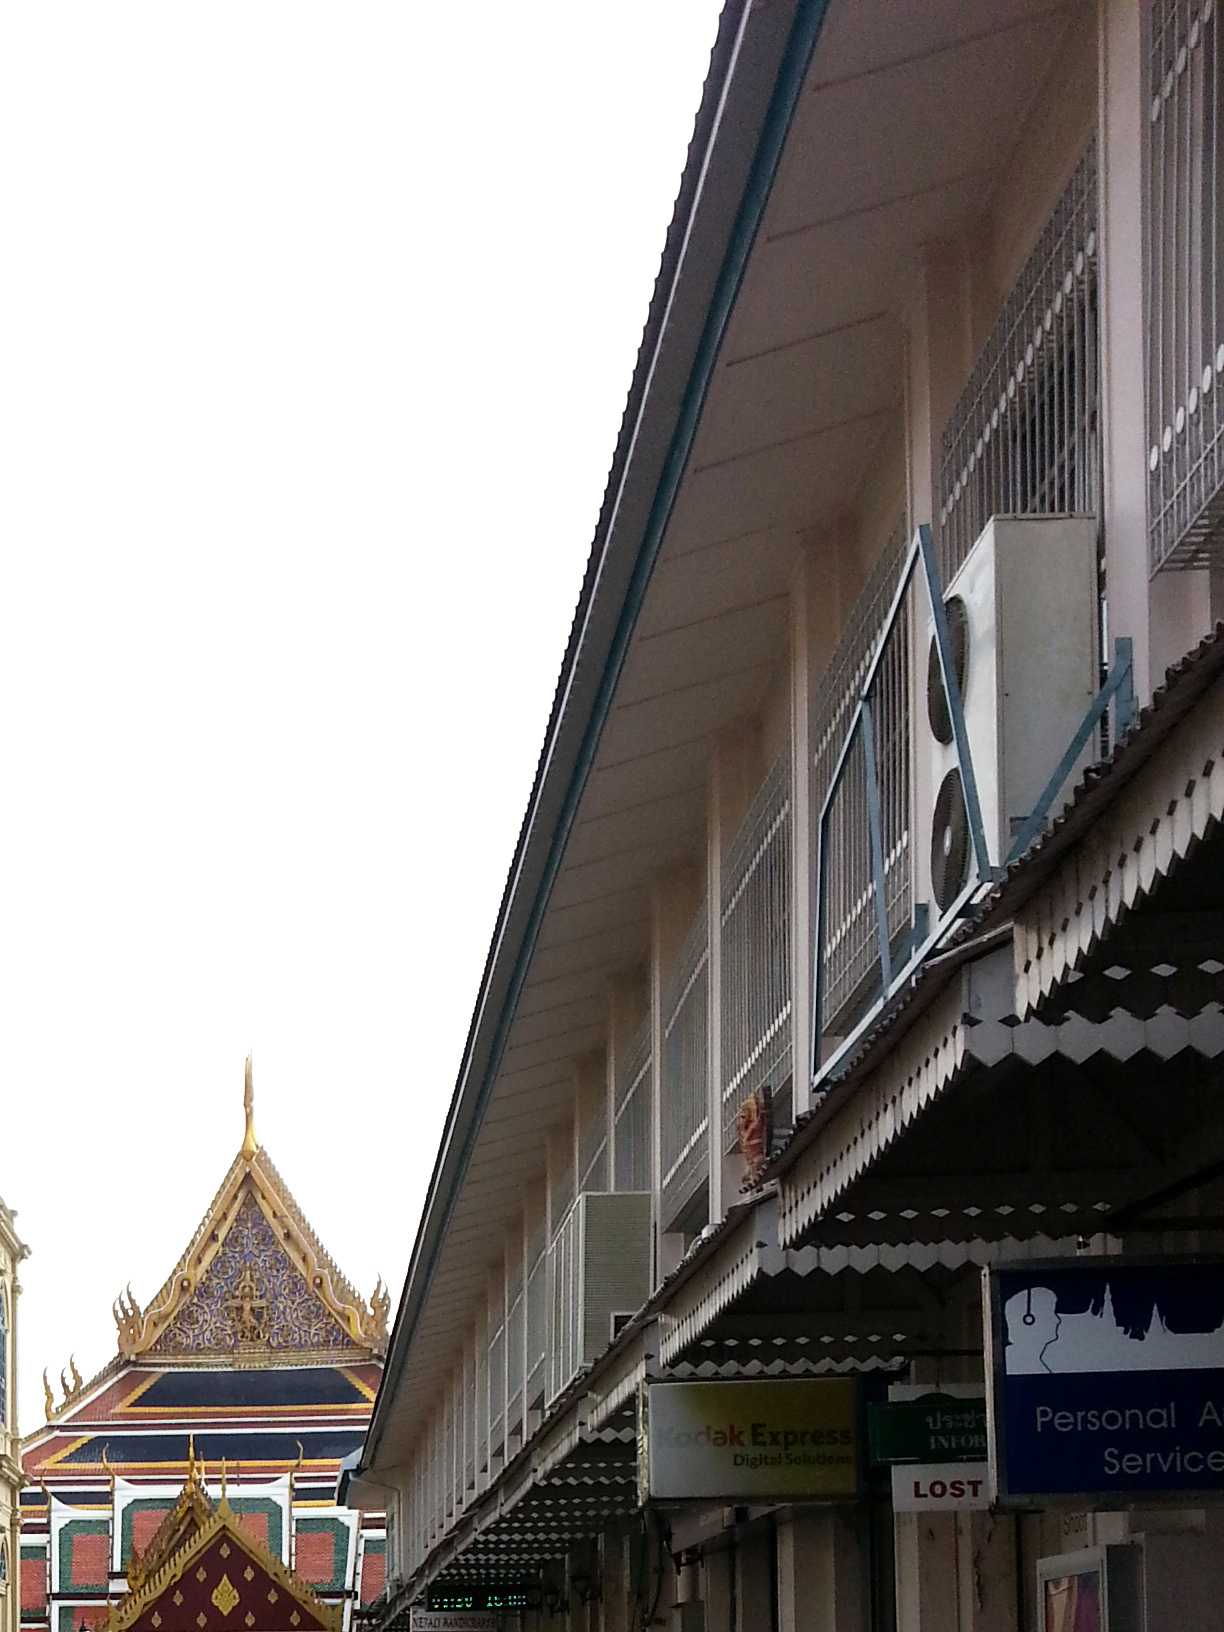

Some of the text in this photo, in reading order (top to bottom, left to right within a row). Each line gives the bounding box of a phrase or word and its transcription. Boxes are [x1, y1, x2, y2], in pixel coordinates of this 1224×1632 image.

[1035, 1400, 1224, 1433] Personal A
[751, 1422, 853, 1450] Express
[733, 1452, 853, 1469] Digital Solutions
[1103, 1444, 1224, 1476] Service
[913, 1479, 983, 1499] LOST
